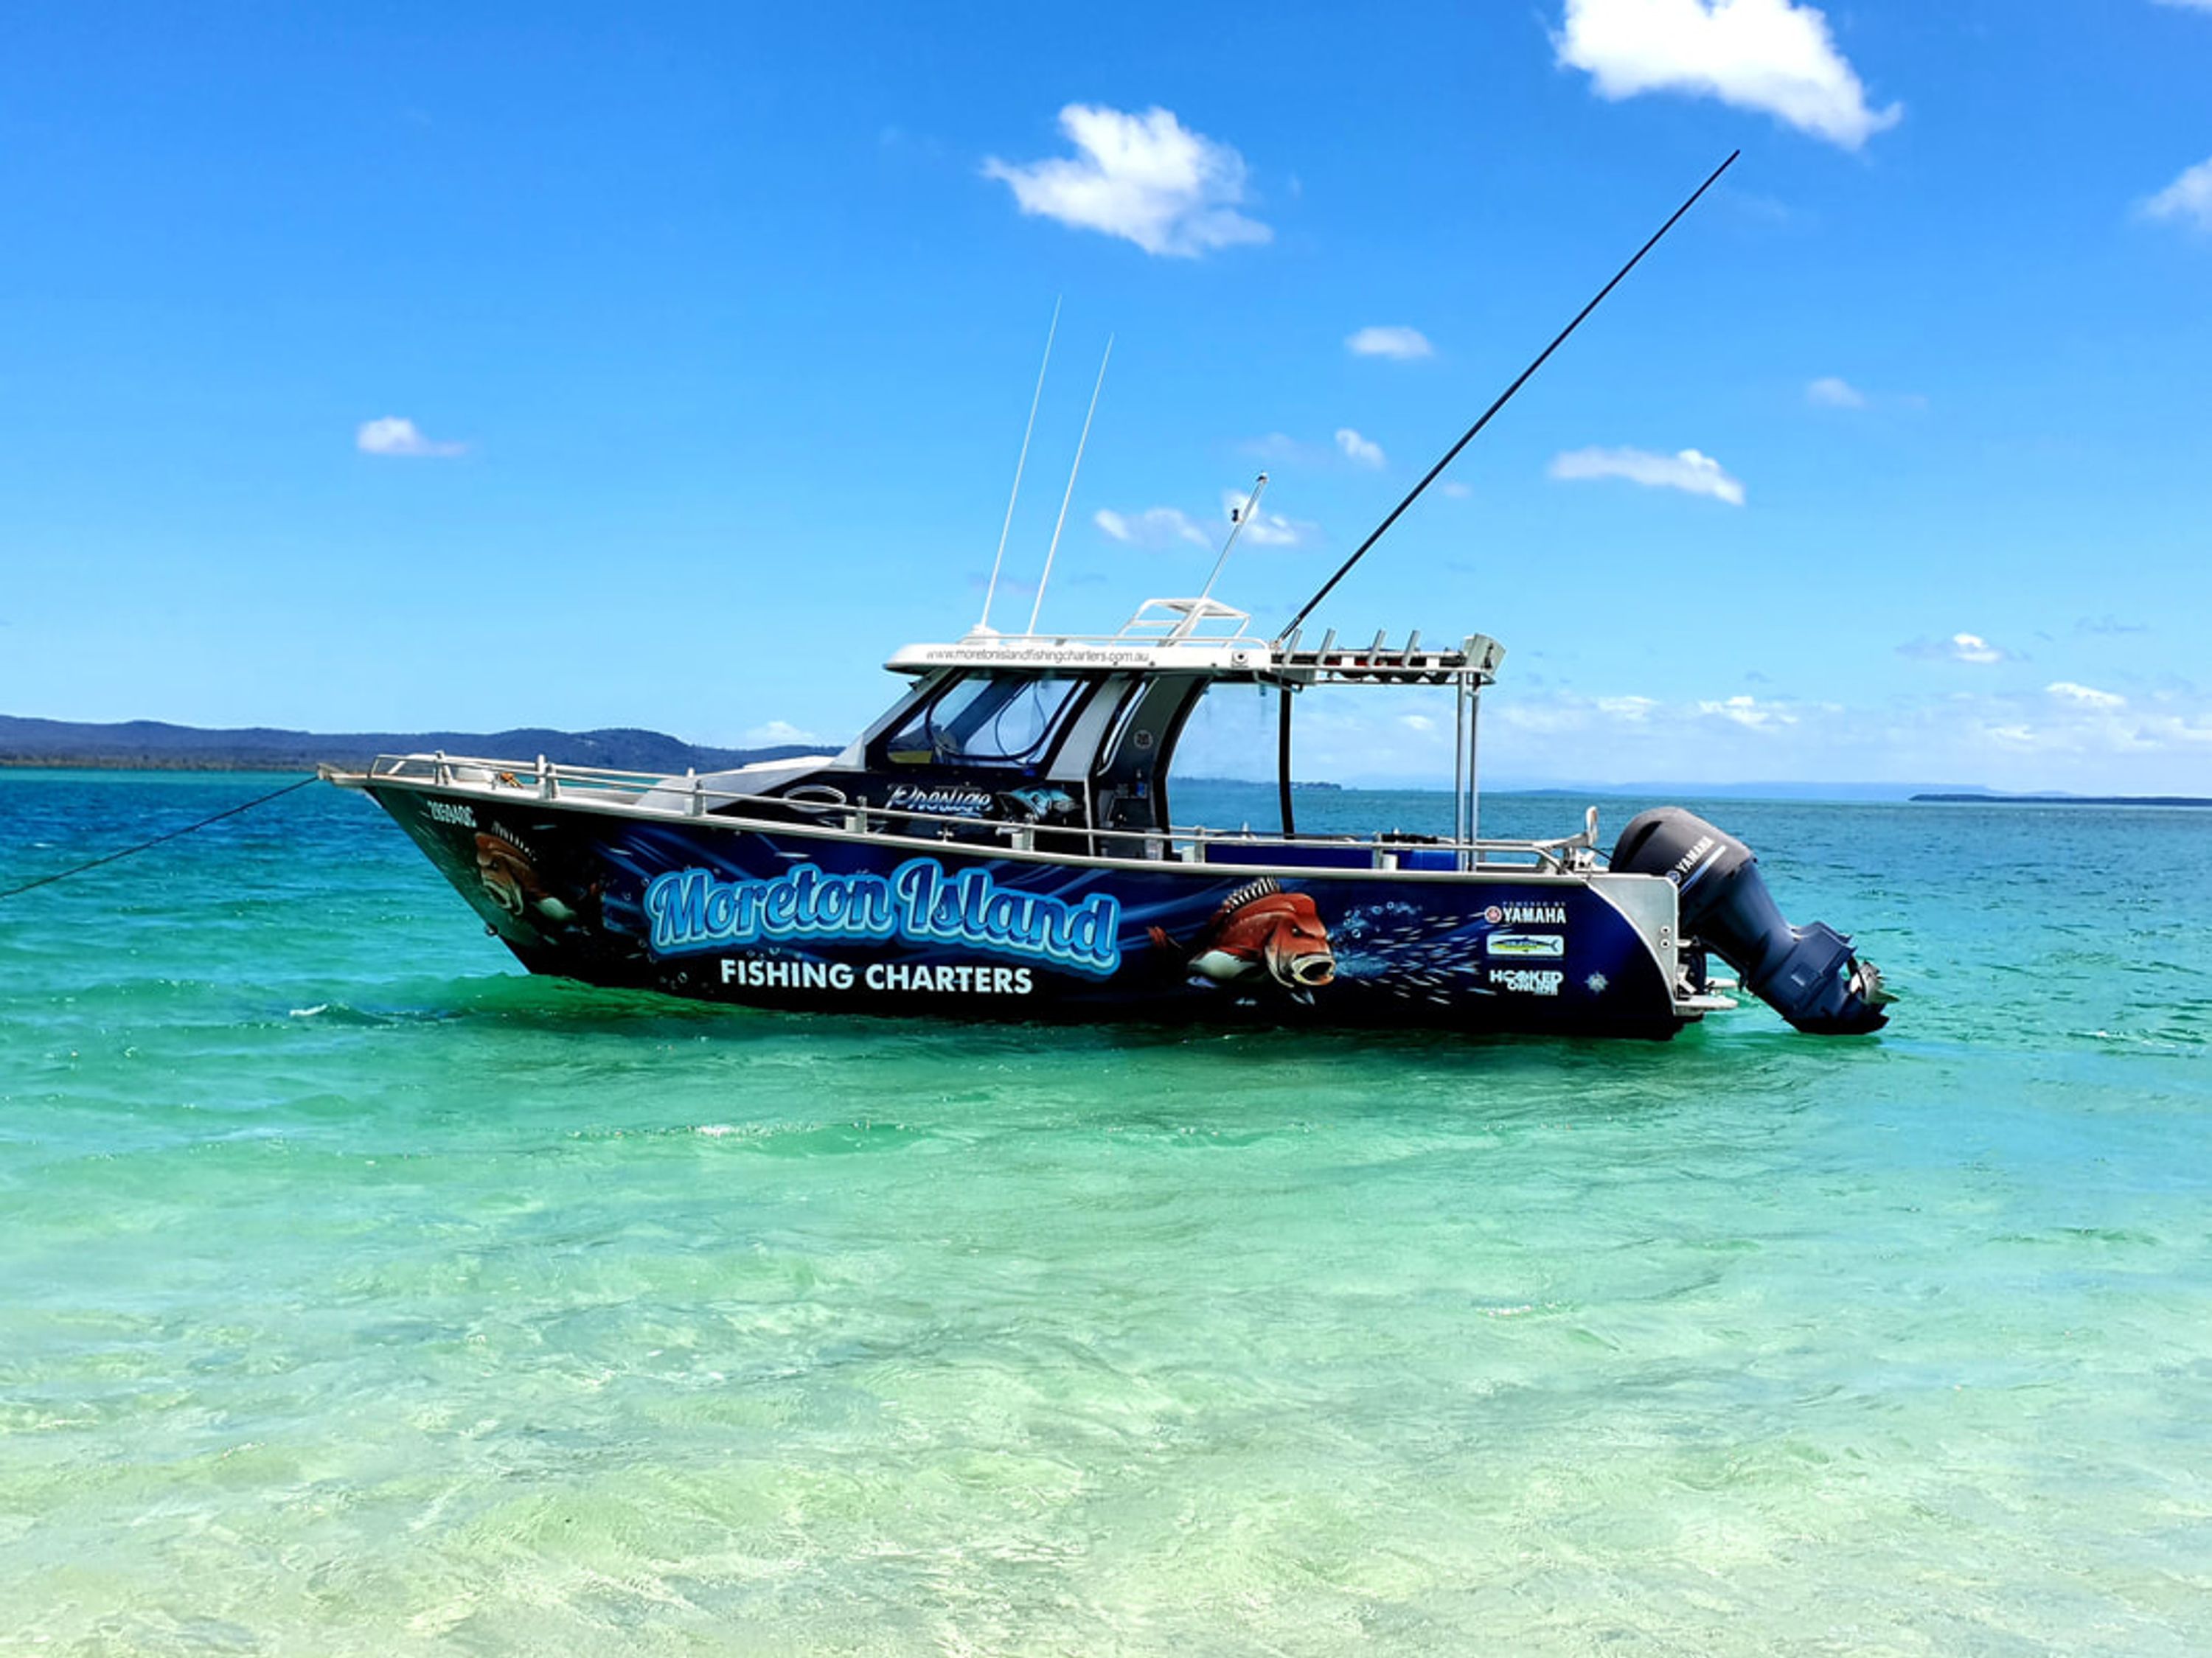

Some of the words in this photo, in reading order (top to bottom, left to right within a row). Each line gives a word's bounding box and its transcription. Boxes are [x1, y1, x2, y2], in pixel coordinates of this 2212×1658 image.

[1675, 835, 1715, 874] YAMAHA
[647, 865, 895, 950] Moreton
[898, 860, 1116, 969] Island
[1503, 907, 1566, 924] YAMAHA
[720, 960, 855, 989] FISHING
[865, 964, 1033, 995] CHARTERS
